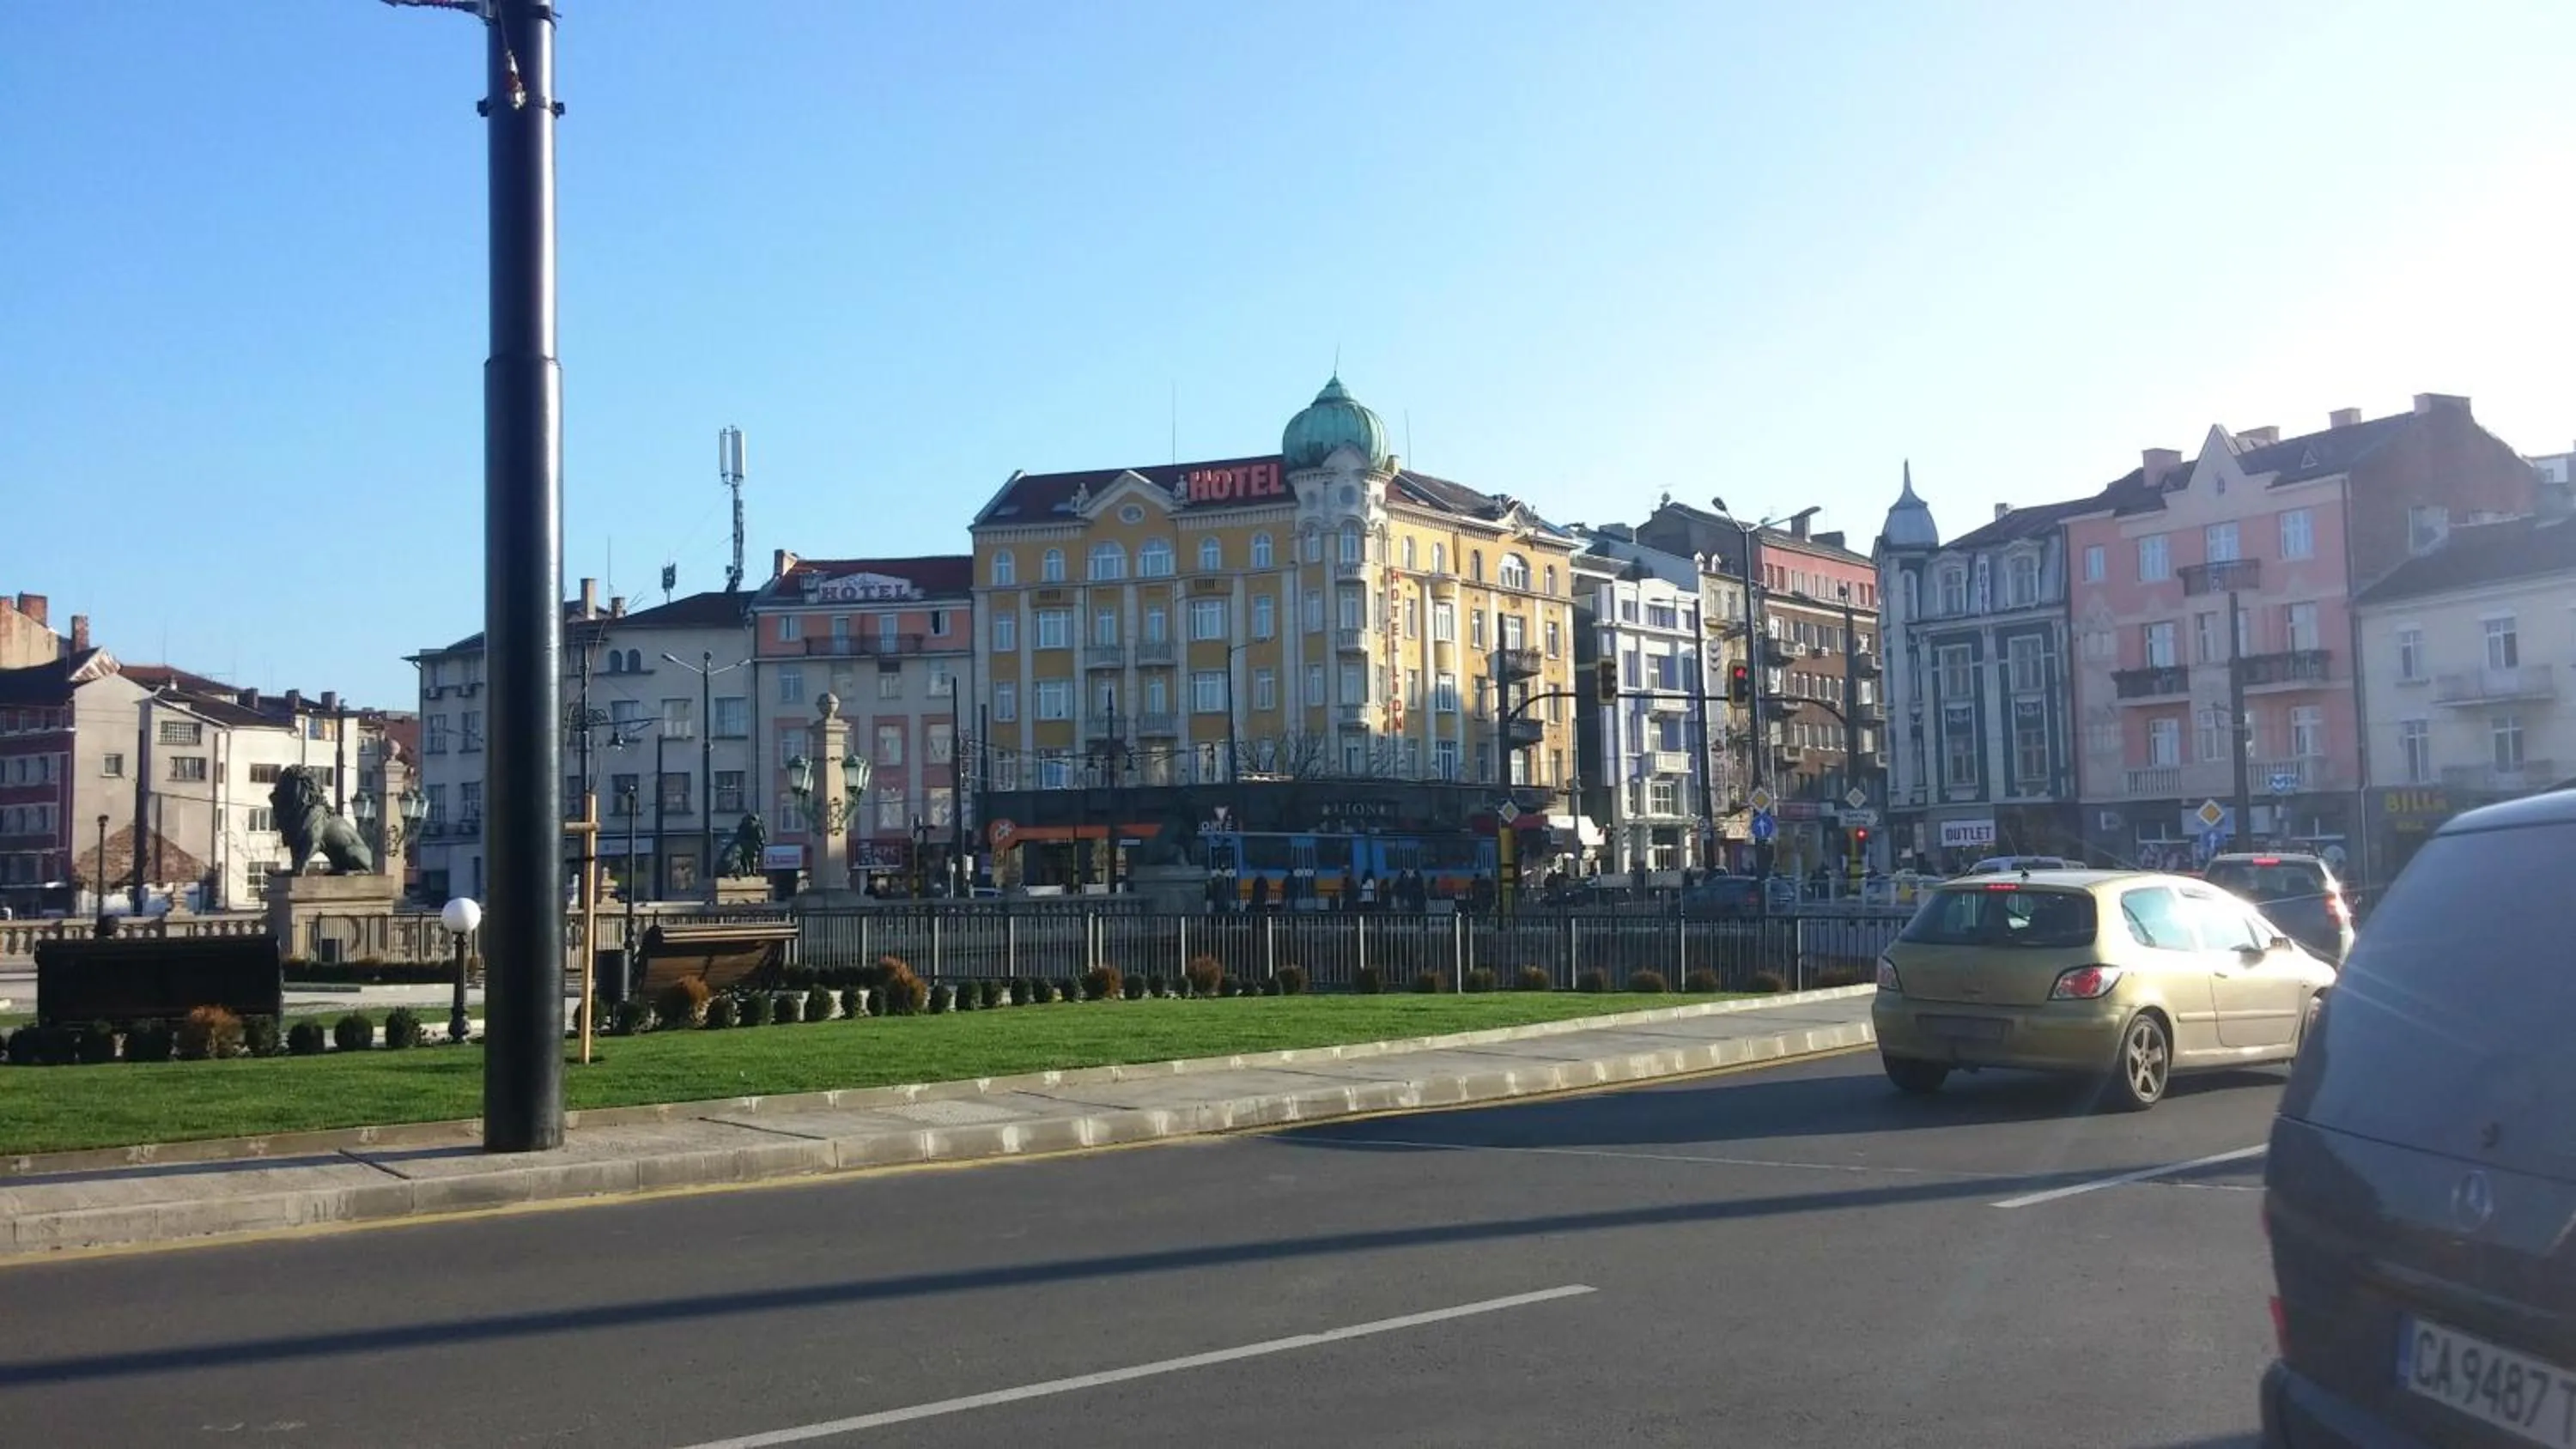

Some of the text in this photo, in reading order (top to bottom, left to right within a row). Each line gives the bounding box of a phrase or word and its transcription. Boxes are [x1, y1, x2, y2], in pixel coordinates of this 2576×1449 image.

[1188, 463, 1286, 502] HOTEL
[821, 584, 908, 600] HOTEL
[1390, 571, 1403, 730] HOTEL LION
[1944, 825, 1992, 841] OUTLET
[2461, 1346, 2551, 1428] 9487
